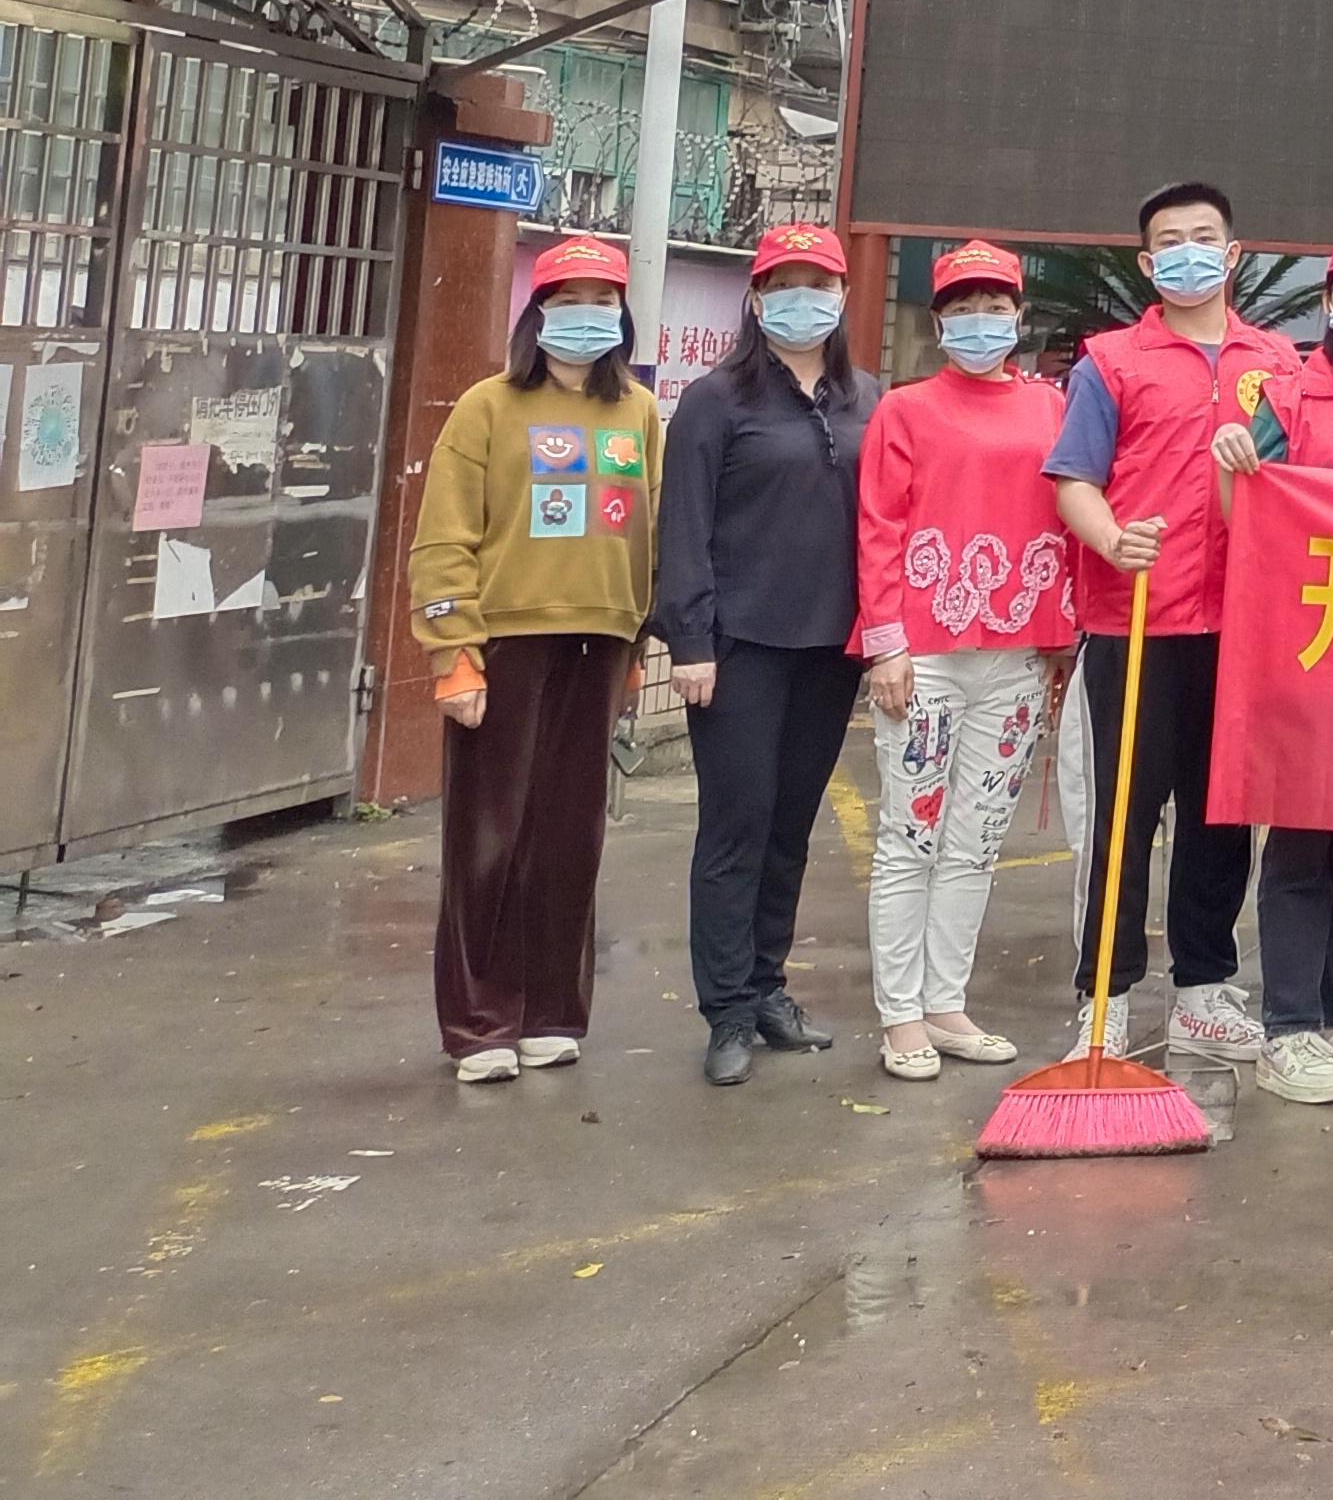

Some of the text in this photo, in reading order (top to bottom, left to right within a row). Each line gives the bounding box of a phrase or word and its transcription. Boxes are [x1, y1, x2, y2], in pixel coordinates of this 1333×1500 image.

[441, 155, 512, 195] 安全应急避难场所
